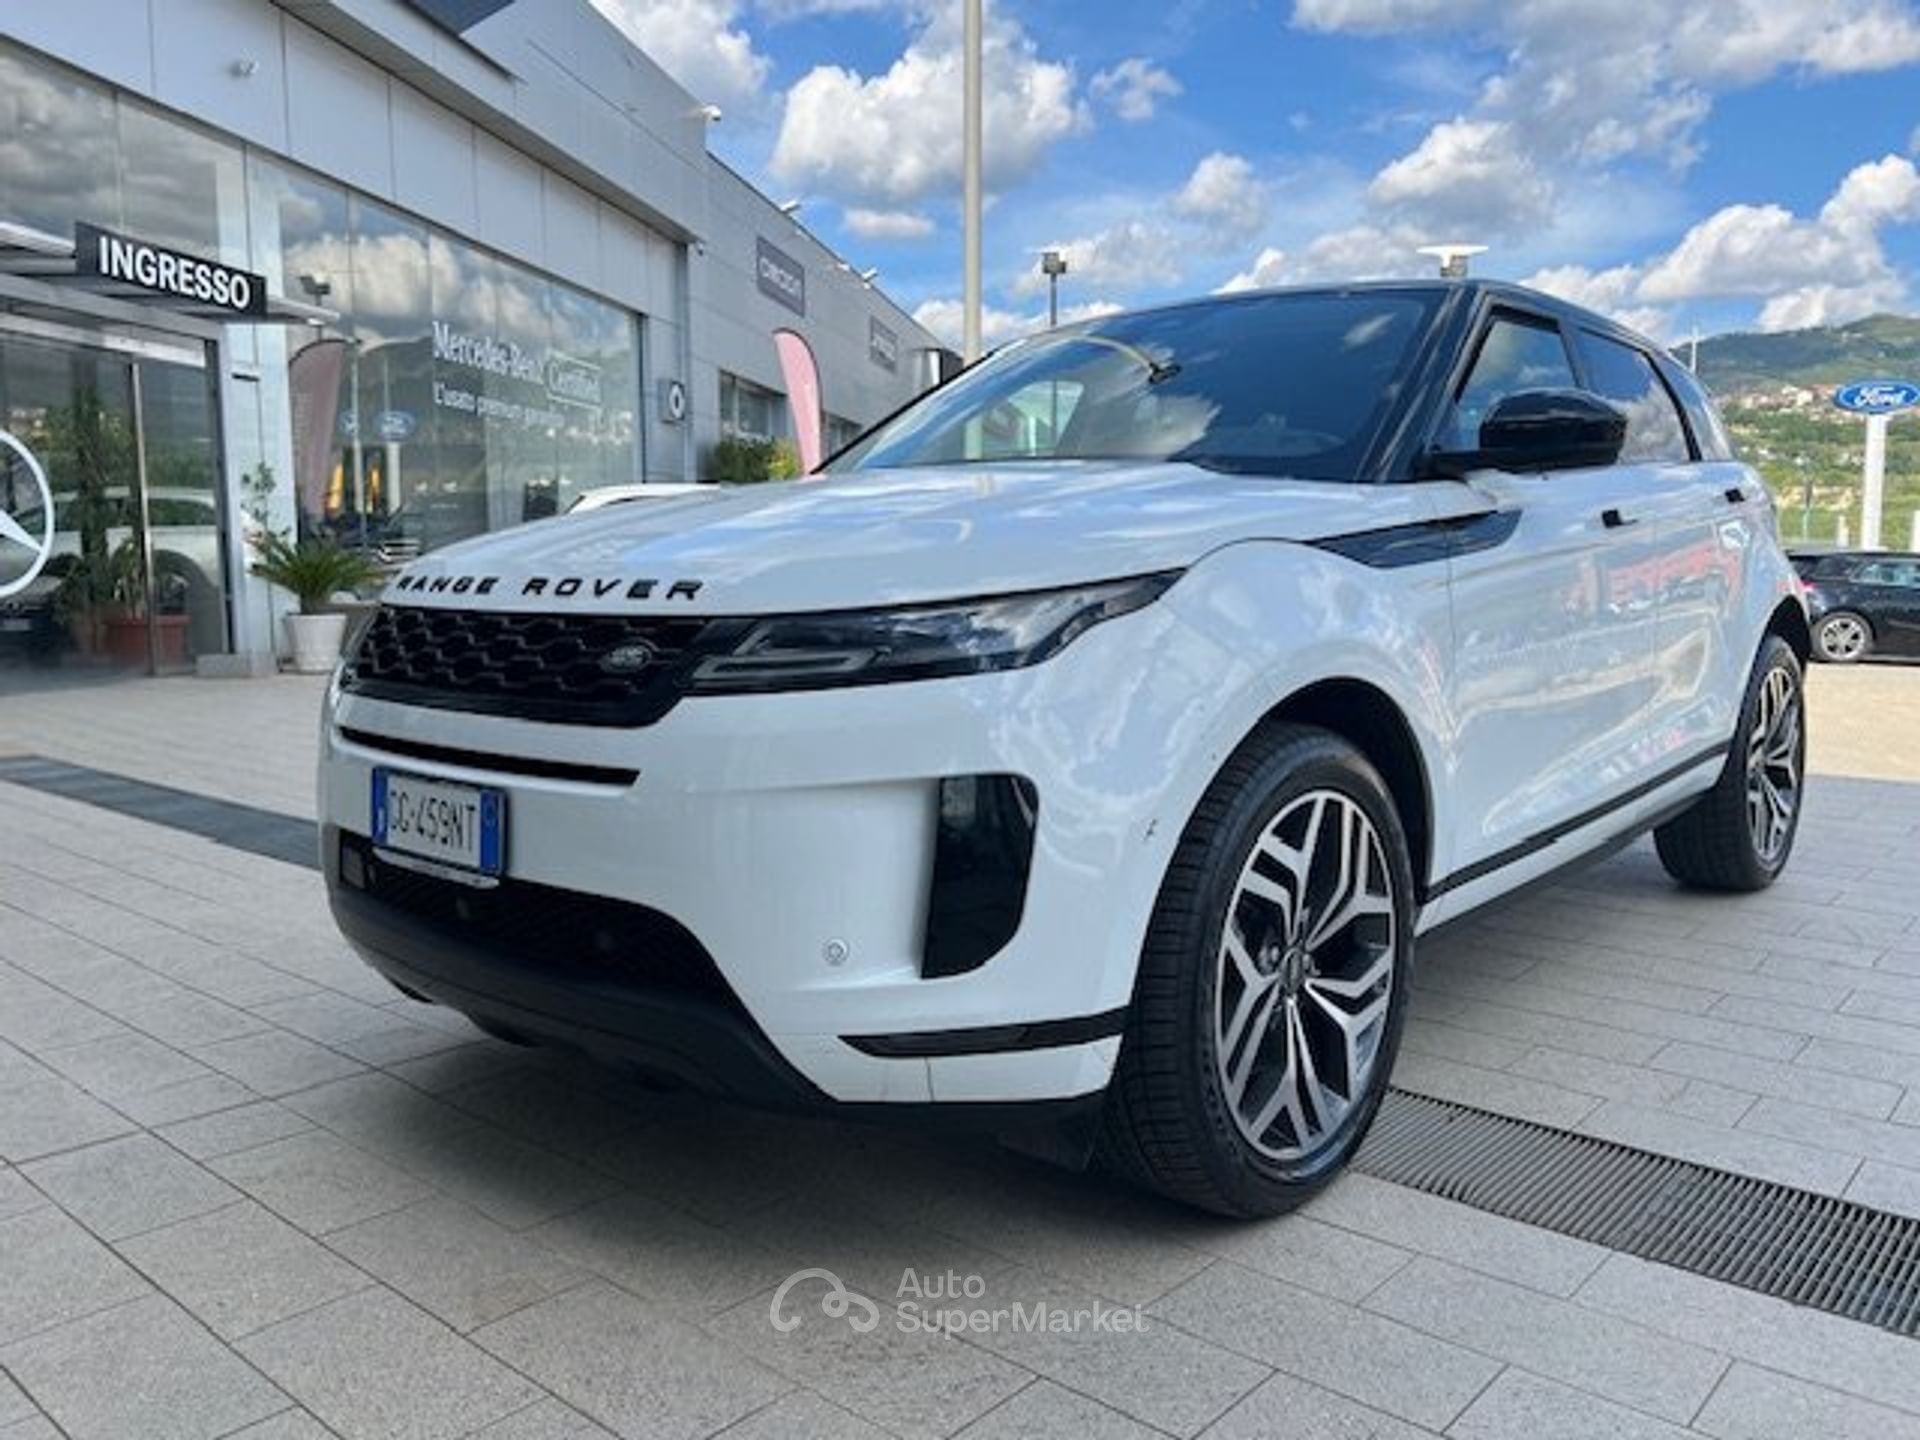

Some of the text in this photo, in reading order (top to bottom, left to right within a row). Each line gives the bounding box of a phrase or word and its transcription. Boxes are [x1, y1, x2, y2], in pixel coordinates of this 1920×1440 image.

[100, 235, 250, 309] INGRESSO
[1854, 386, 1907, 406] Ford
[399, 575, 704, 601] RANGE ROVER
